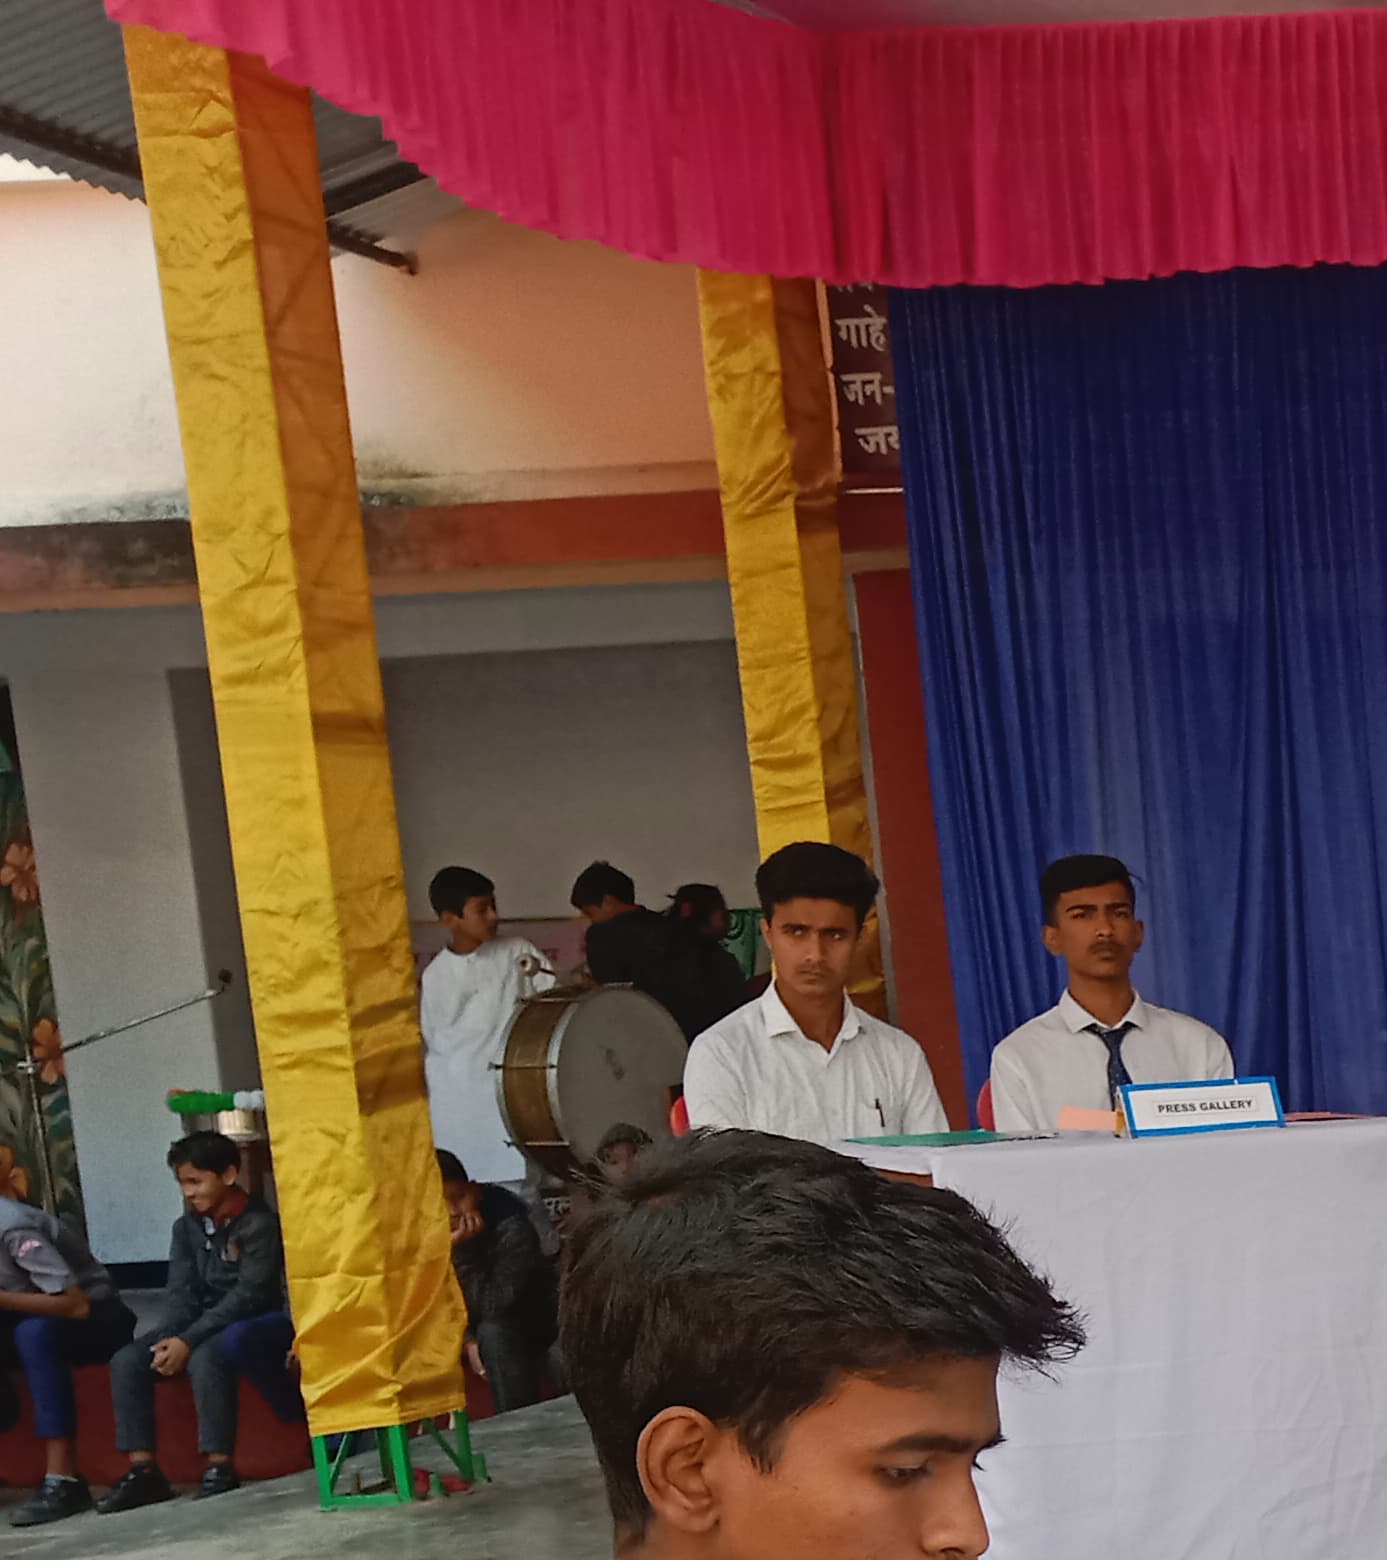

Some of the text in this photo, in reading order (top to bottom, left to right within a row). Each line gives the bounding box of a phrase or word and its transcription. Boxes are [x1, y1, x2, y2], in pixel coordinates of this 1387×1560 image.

[834, 304, 887, 351] गाहे
[1157, 1100, 1252, 1113] PRESS GALLERY
